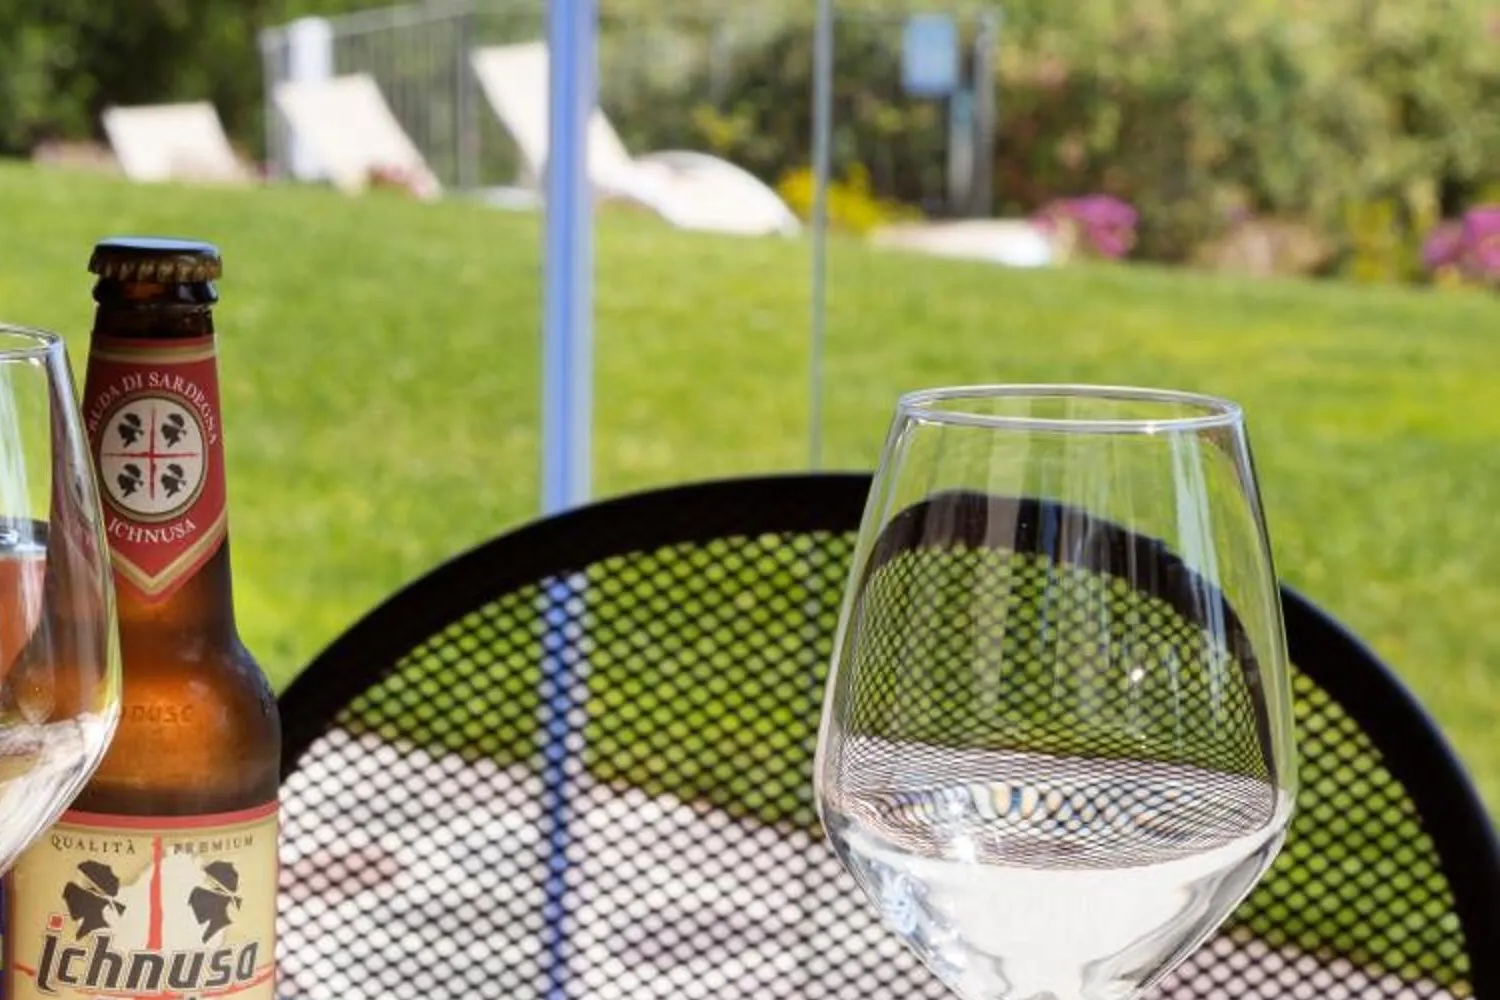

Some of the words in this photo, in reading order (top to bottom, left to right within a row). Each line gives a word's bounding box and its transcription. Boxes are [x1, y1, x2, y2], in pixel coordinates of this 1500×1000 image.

[122, 371, 143, 392] DI
[108, 517, 197, 543] ICHNUSA
[50, 834, 136, 855] QUALITÀ
[172, 835, 254, 855] PREMIUM
